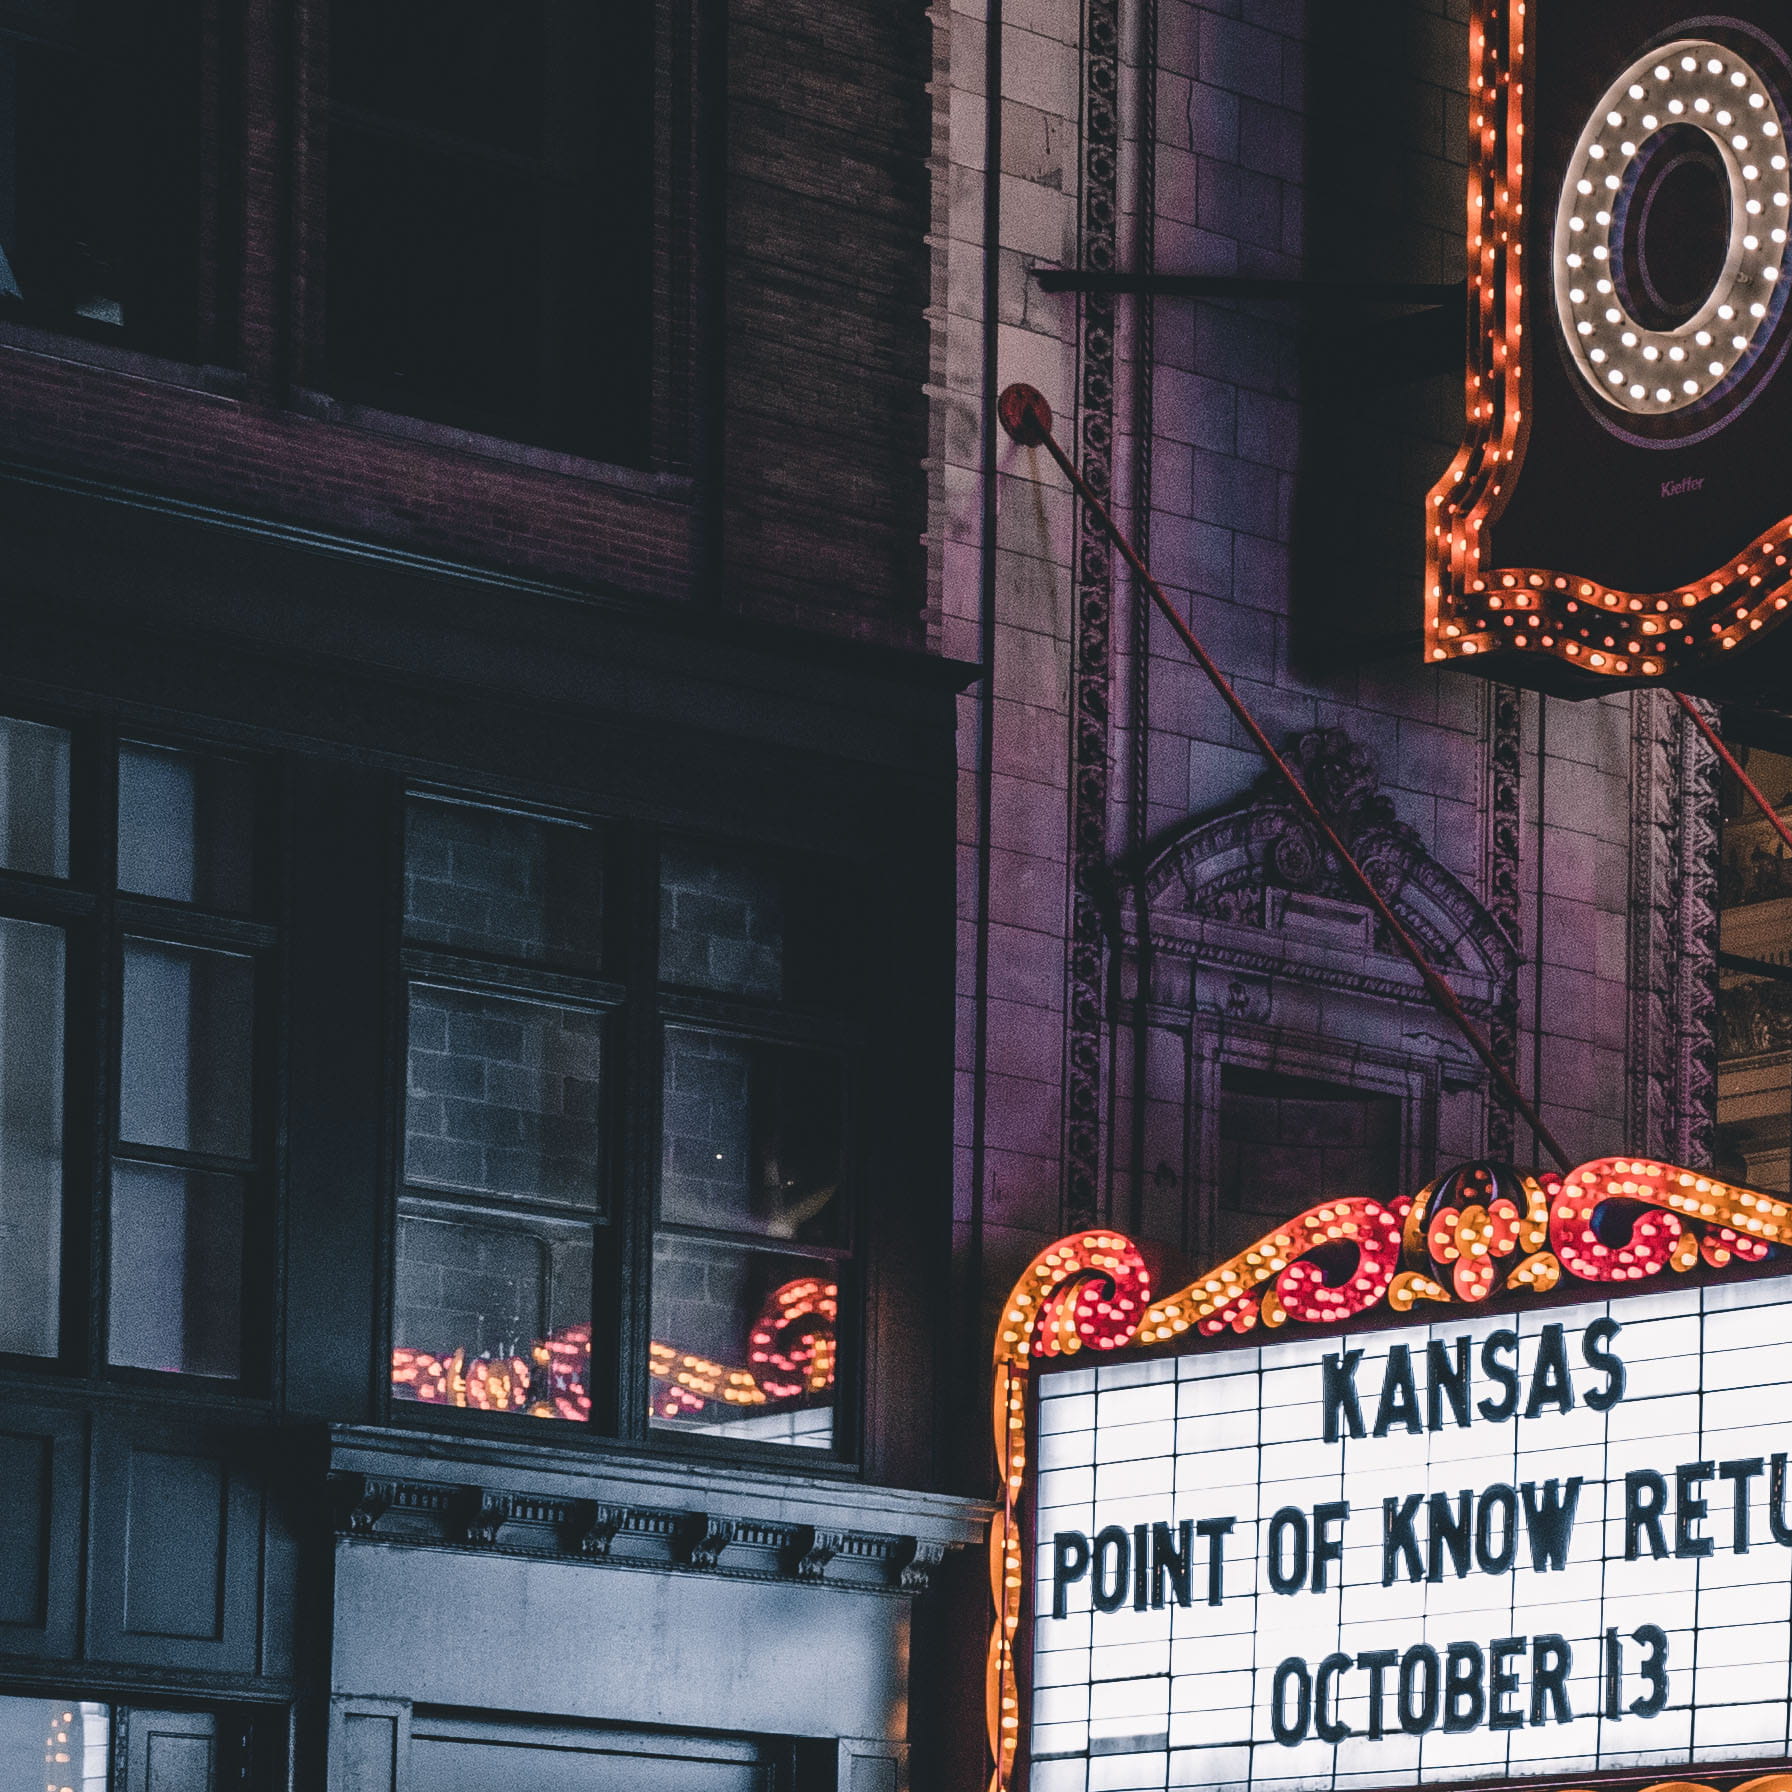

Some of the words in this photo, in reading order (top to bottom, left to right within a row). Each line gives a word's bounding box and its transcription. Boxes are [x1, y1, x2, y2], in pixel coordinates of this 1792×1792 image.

[1552, 39, 1791, 415] O
[1660, 476, 1705, 498] Kieffer
[1322, 1317, 1626, 1444] KANSAS
[1052, 1516, 1237, 1620] POINT
[1267, 1500, 1350, 1595] OF
[1382, 1476, 1585, 1587] KNOW
[1271, 1632, 1574, 1748] OCTOBER
[1604, 1623, 1669, 1721] 13
